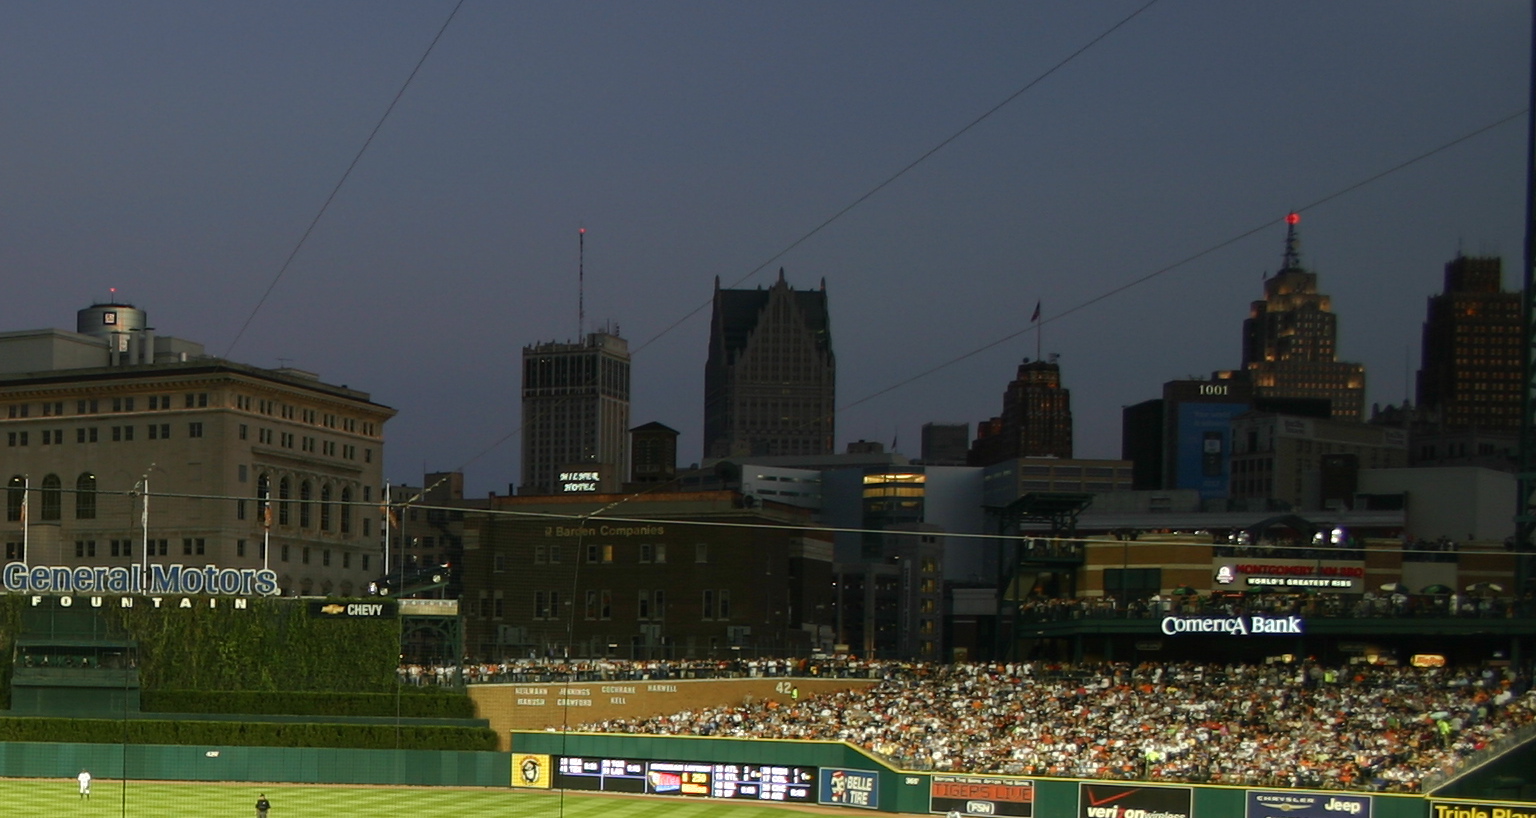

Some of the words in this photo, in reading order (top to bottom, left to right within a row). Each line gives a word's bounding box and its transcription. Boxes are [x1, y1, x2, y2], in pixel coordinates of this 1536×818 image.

[1199, 384, 1229, 396] 1001
[564, 483, 595, 492] HOTEL
[600, 525, 664, 537] Companies
[3, 561, 142, 595] General
[150, 564, 277, 596] Motors
[31, 596, 248, 609] FOUNTAIN
[347, 604, 383, 616] CHEVY
[1251, 616, 1301, 633] Bank
[601, 686, 636, 694] COCHRANE
[647, 685, 677, 693] HARWELL
[775, 682, 791, 694] 42
[557, 699, 592, 707] CRAWFORD
[847, 776, 873, 791] BELLE
[849, 790, 869, 805] TIRE
[935, 784, 989, 799] TIGERS
[996, 787, 1031, 800] LIVE
[1087, 805, 1145, 818] verizon
[1325, 797, 1361, 814] Jeep
